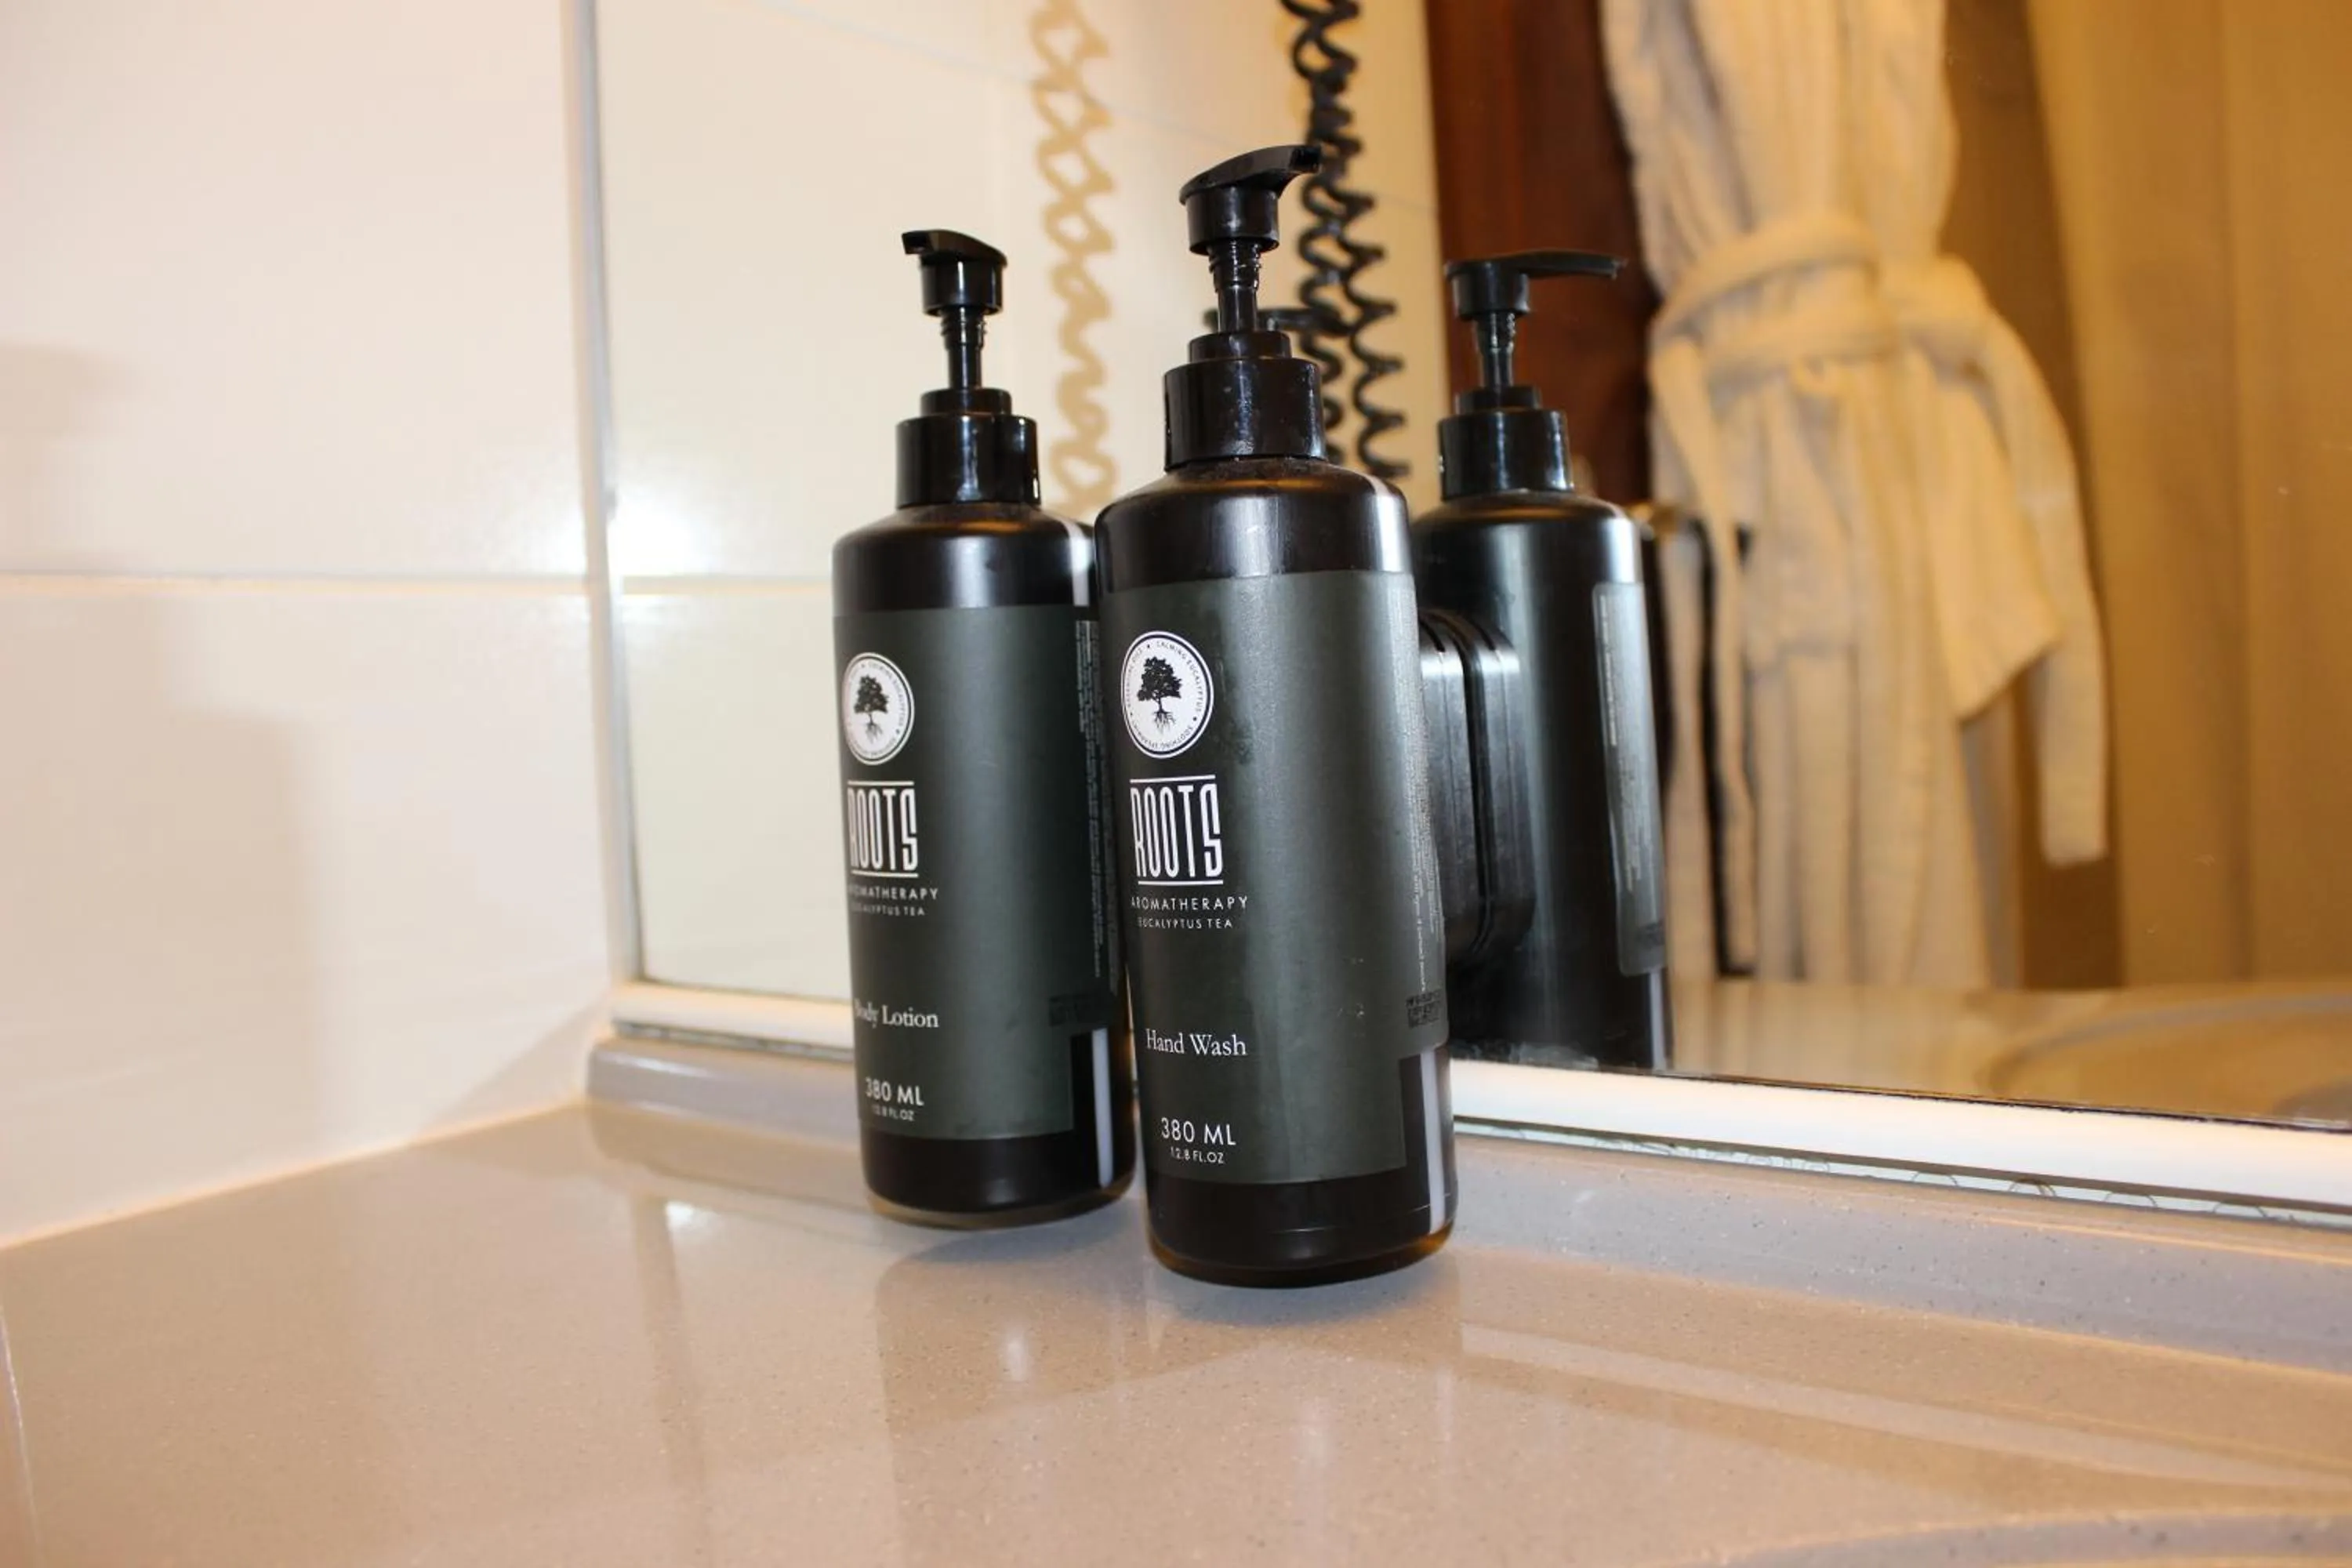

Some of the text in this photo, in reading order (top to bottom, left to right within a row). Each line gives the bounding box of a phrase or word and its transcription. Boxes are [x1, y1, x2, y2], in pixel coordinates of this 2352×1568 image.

[848, 787, 919, 871] ROOTS
[1130, 783, 1223, 877] ROOTS
[850, 884, 938, 900] OMATHERAPY
[1131, 895, 1247, 911] AROMATHERAPY
[904, 906, 926, 916] TEA
[1138, 916, 1233, 929] EUCALYPTUS TEA
[882, 1004, 939, 1029] Lotion
[1145, 1028, 1247, 1056] Hand Wash
[866, 1076, 925, 1107] 380 ML
[1161, 1117, 1236, 1146] 380 ML
